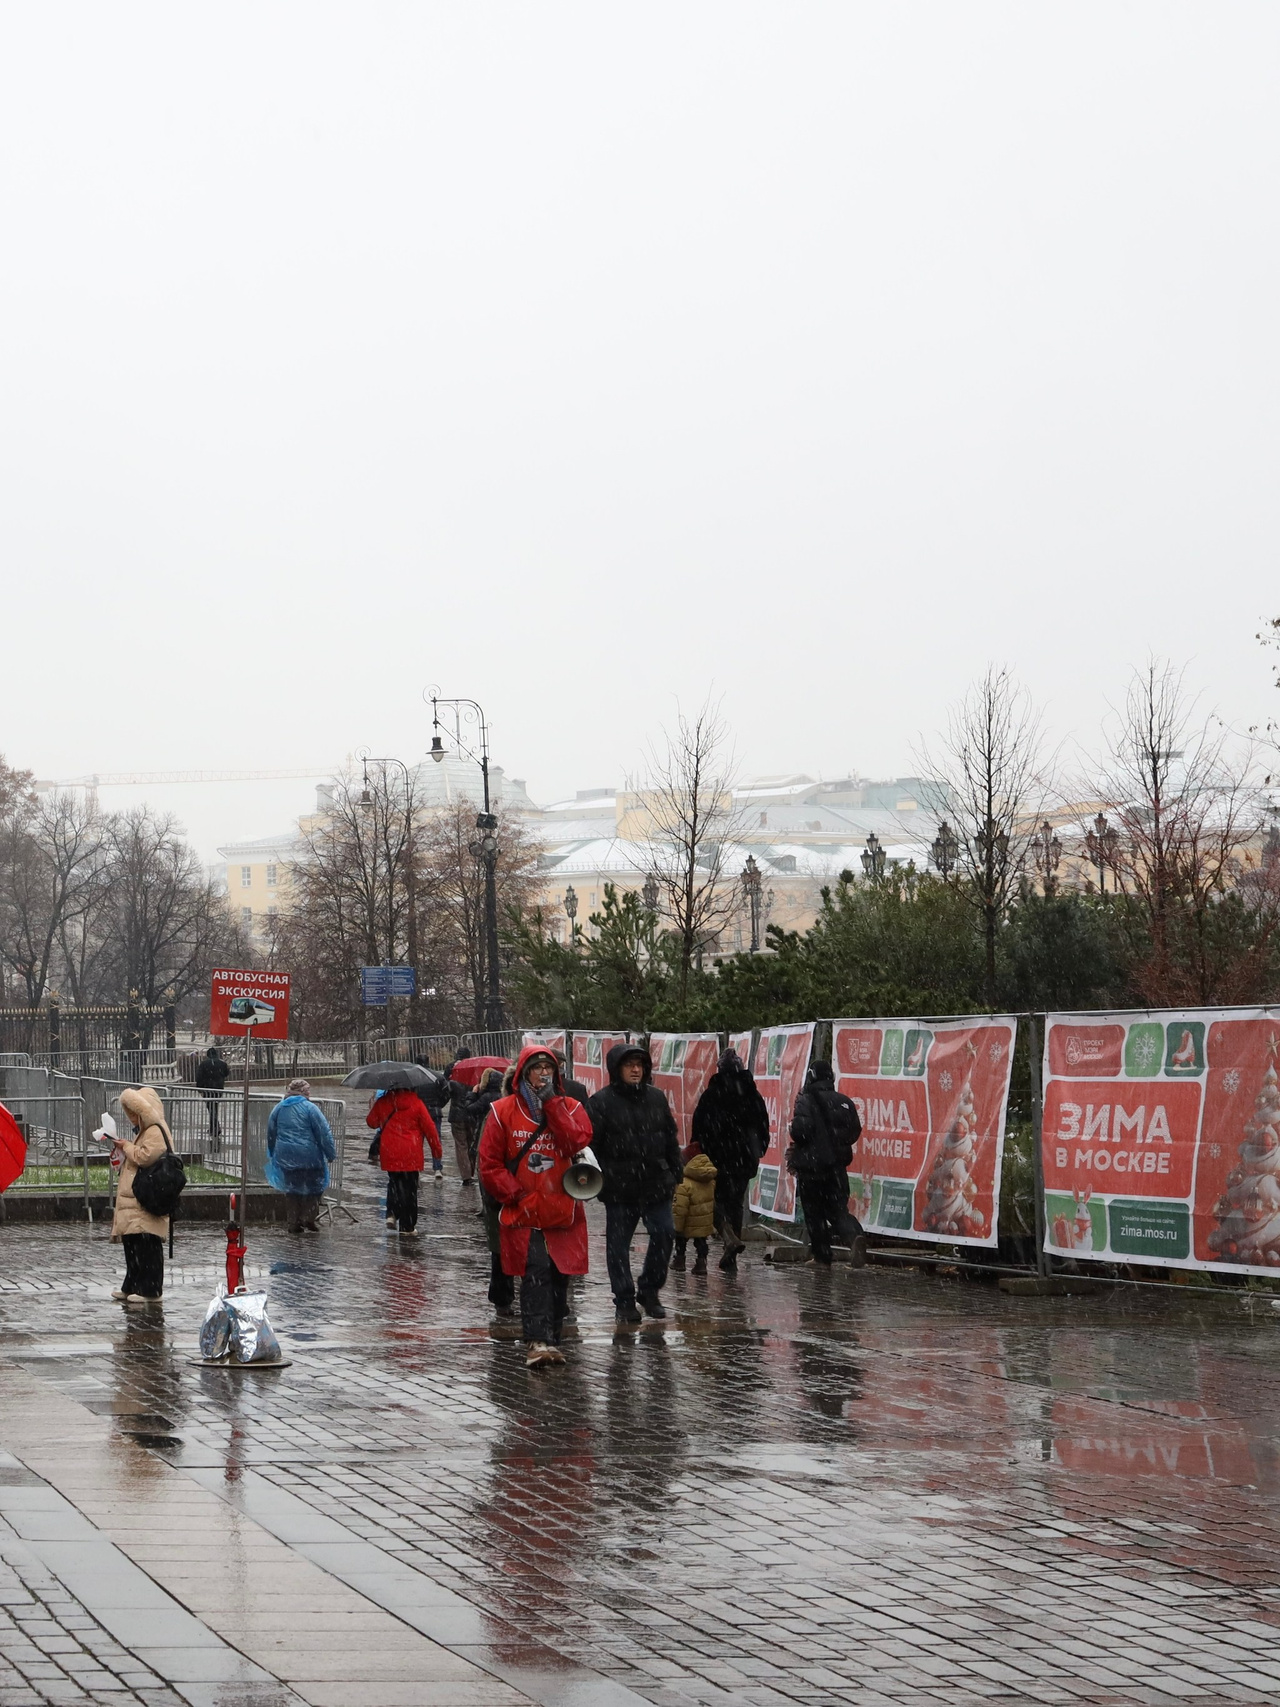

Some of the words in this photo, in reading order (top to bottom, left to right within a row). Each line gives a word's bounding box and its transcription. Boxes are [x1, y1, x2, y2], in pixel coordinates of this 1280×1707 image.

[213, 970, 289, 985] АВТОБУСНАЯ
[217, 986, 286, 1000] ЭКСКУРСИЯ
[1056, 1102, 1173, 1145] ЗИМА
[862, 1137, 912, 1159] МОСКВЕ
[1055, 1147, 1068, 1168] В
[1074, 1149, 1171, 1174] МОСКВЕ
[1120, 1224, 1178, 1240] zima.mos.ru
